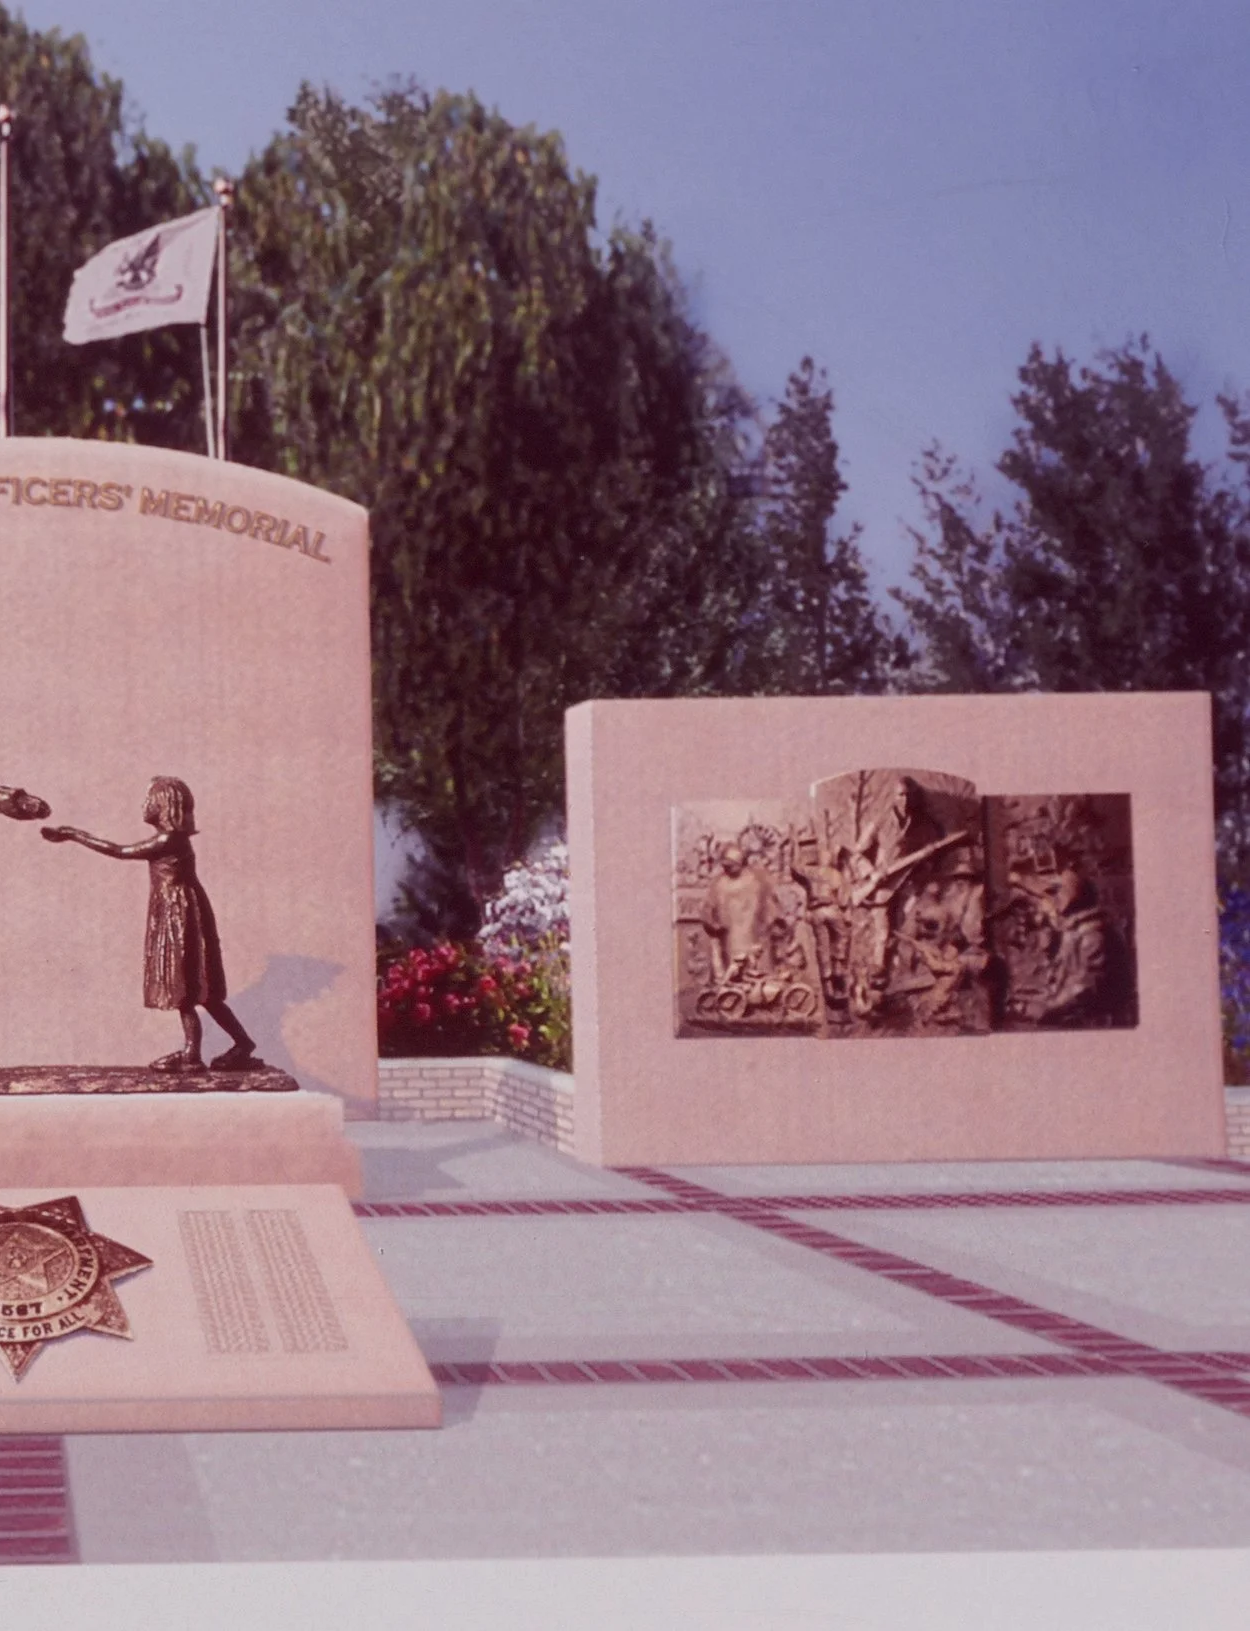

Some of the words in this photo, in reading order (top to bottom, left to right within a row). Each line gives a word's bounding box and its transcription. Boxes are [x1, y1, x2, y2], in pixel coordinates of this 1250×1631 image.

[139, 487, 332, 564] MEMORIAL
[22, 1322, 54, 1338] FOR
[58, 1311, 85, 1331] ALL
